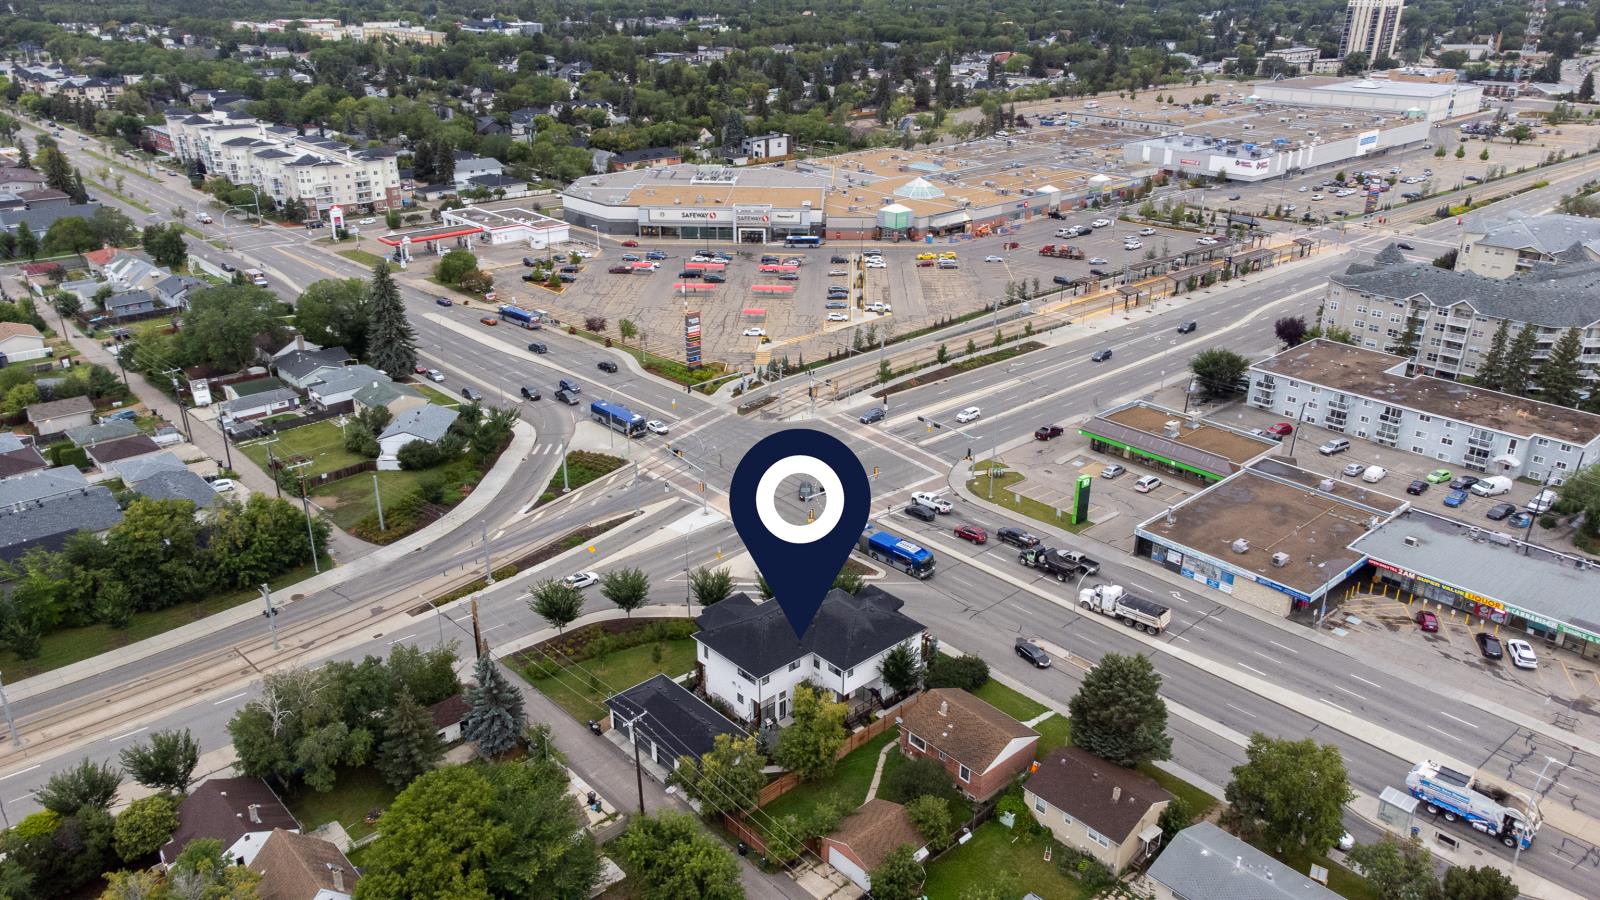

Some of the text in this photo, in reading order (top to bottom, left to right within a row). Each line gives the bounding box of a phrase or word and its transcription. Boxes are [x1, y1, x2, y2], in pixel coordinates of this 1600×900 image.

[1398, 568, 1416, 580] 2AM
[1417, 576, 1501, 608] SUPER VALUE LIQUOR
